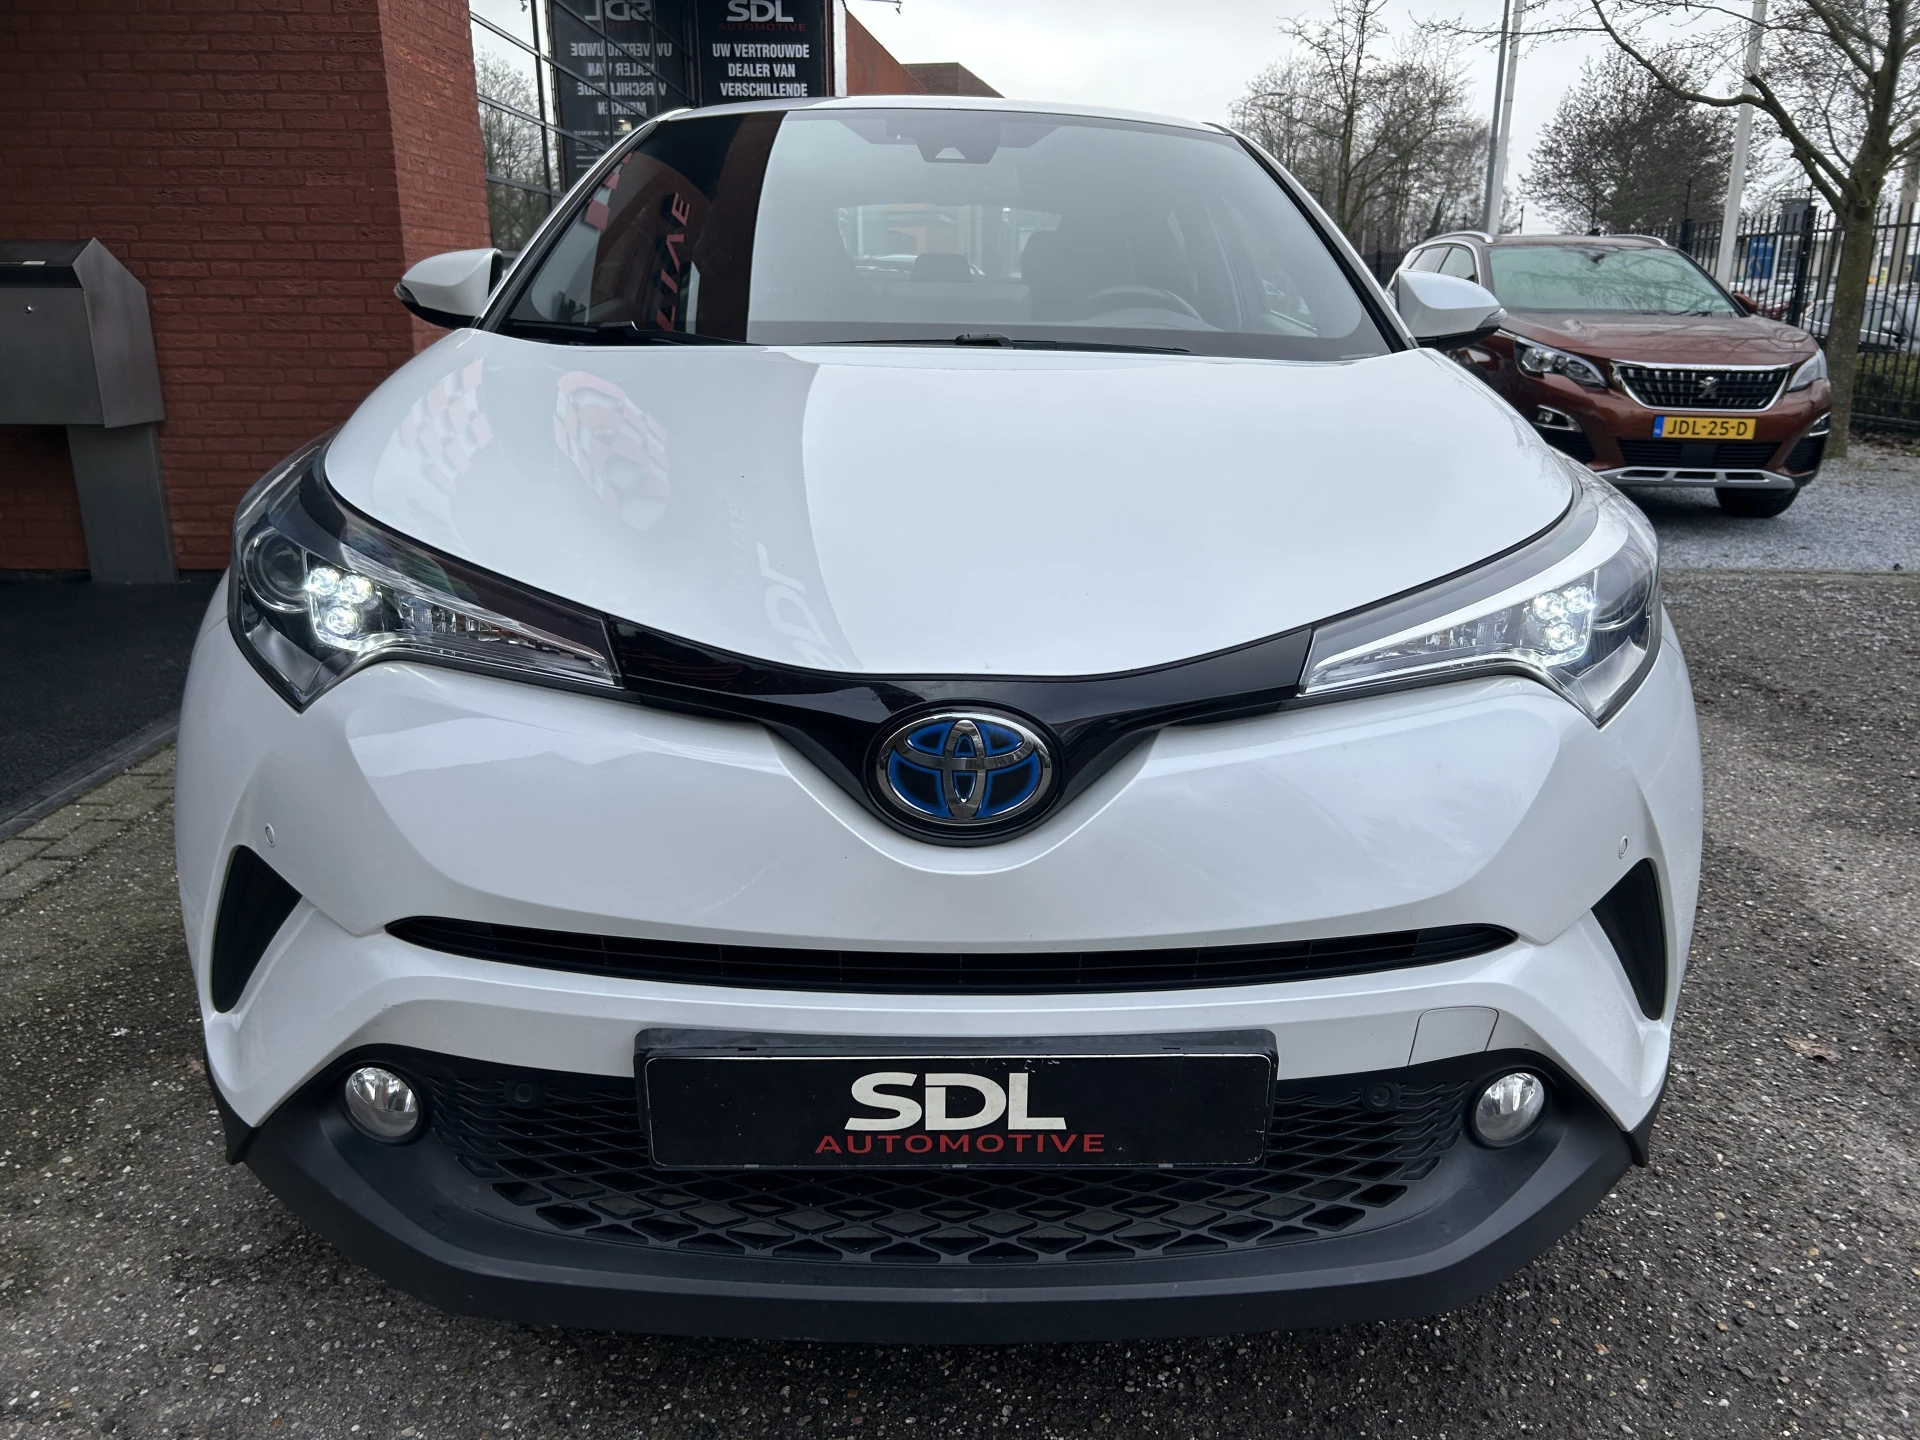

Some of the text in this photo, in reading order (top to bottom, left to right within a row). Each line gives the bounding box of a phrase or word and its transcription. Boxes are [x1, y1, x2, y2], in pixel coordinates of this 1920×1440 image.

[726, 0, 794, 22] SDL
[717, 23, 807, 32] AUTOMOTIVE
[712, 43, 810, 58] UW VERTROUWDE
[728, 63, 796, 78] DEALER VAN
[720, 82, 808, 97] VERSCHILLENDE
[1668, 420, 1748, 436] JDL-25-D
[844, 1072, 1066, 1132] SDL
[815, 1133, 1105, 1154] AUTOMOTIVE
